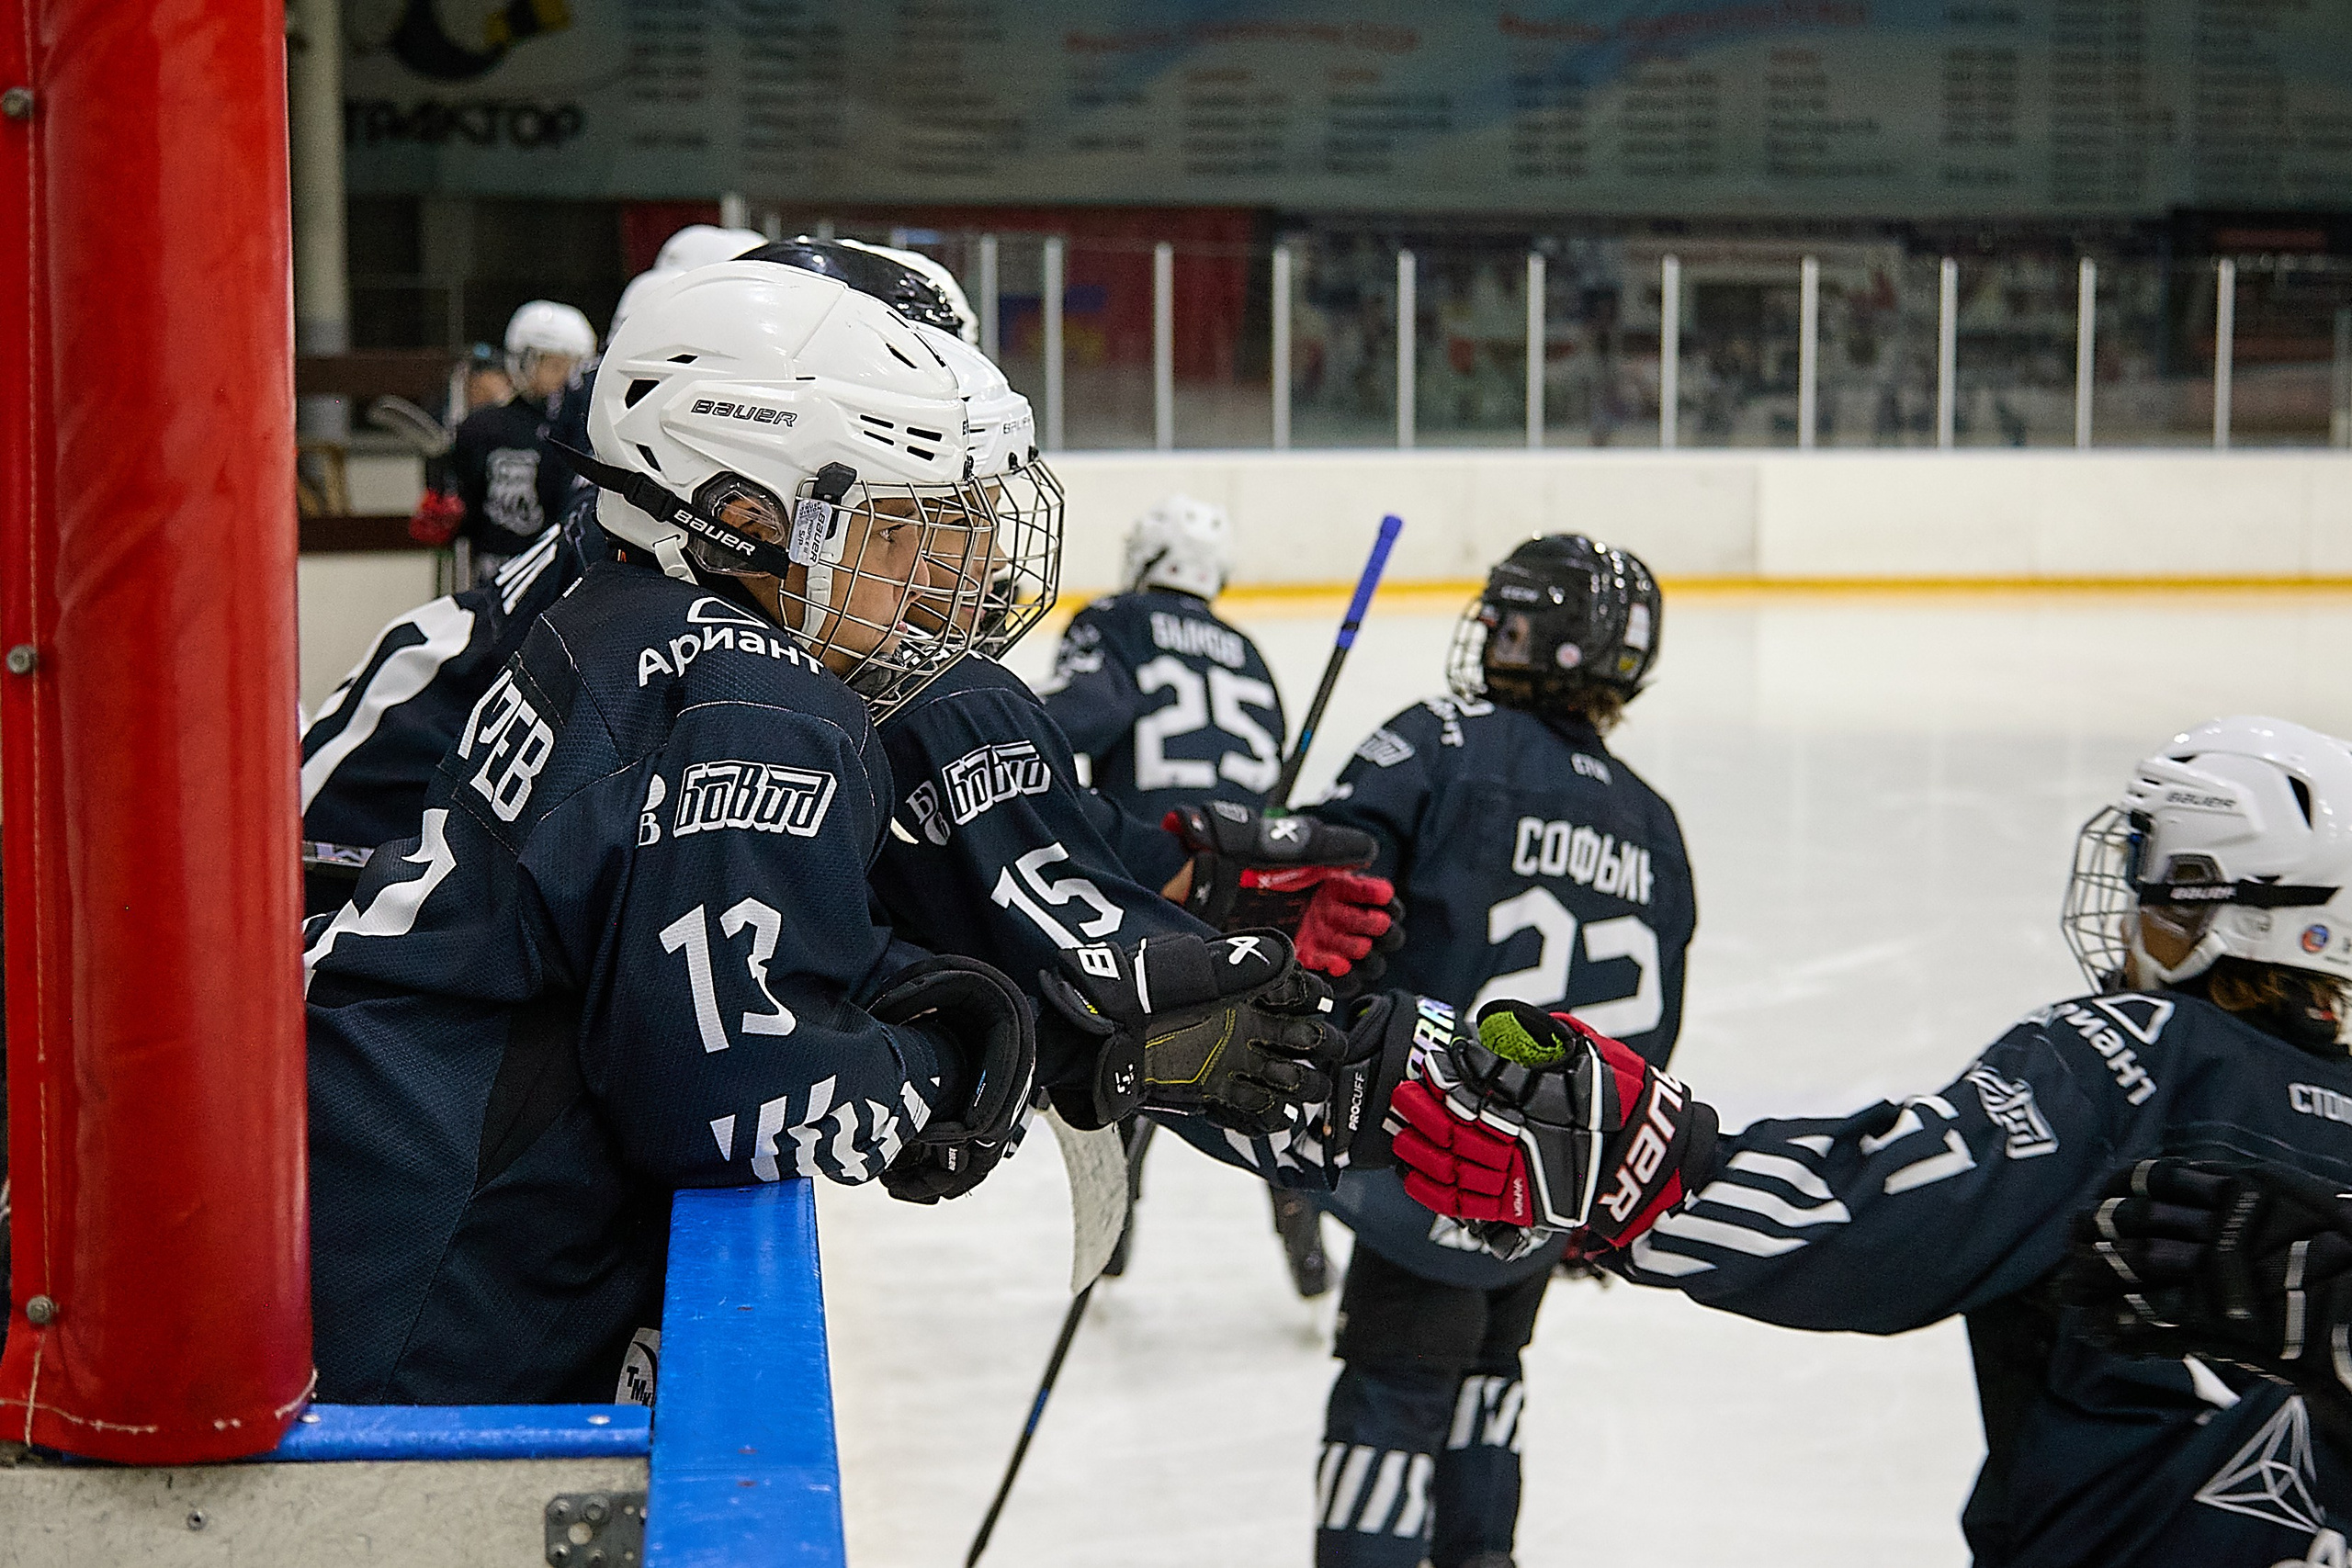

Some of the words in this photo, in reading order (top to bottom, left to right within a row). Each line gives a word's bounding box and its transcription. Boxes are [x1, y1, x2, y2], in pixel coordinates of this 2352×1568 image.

[690, 398, 797, 429] BAUER
[673, 508, 756, 557] BAUER
[809, 513, 826, 563] BAUER
[639, 626, 824, 687] Ариант
[1136, 655, 1282, 794] 25
[990, 841, 1125, 950] 15
[659, 897, 797, 1053] 13
[1470, 886, 1664, 1036] 22
[1348, 1071, 1365, 1131] PROCUFF
